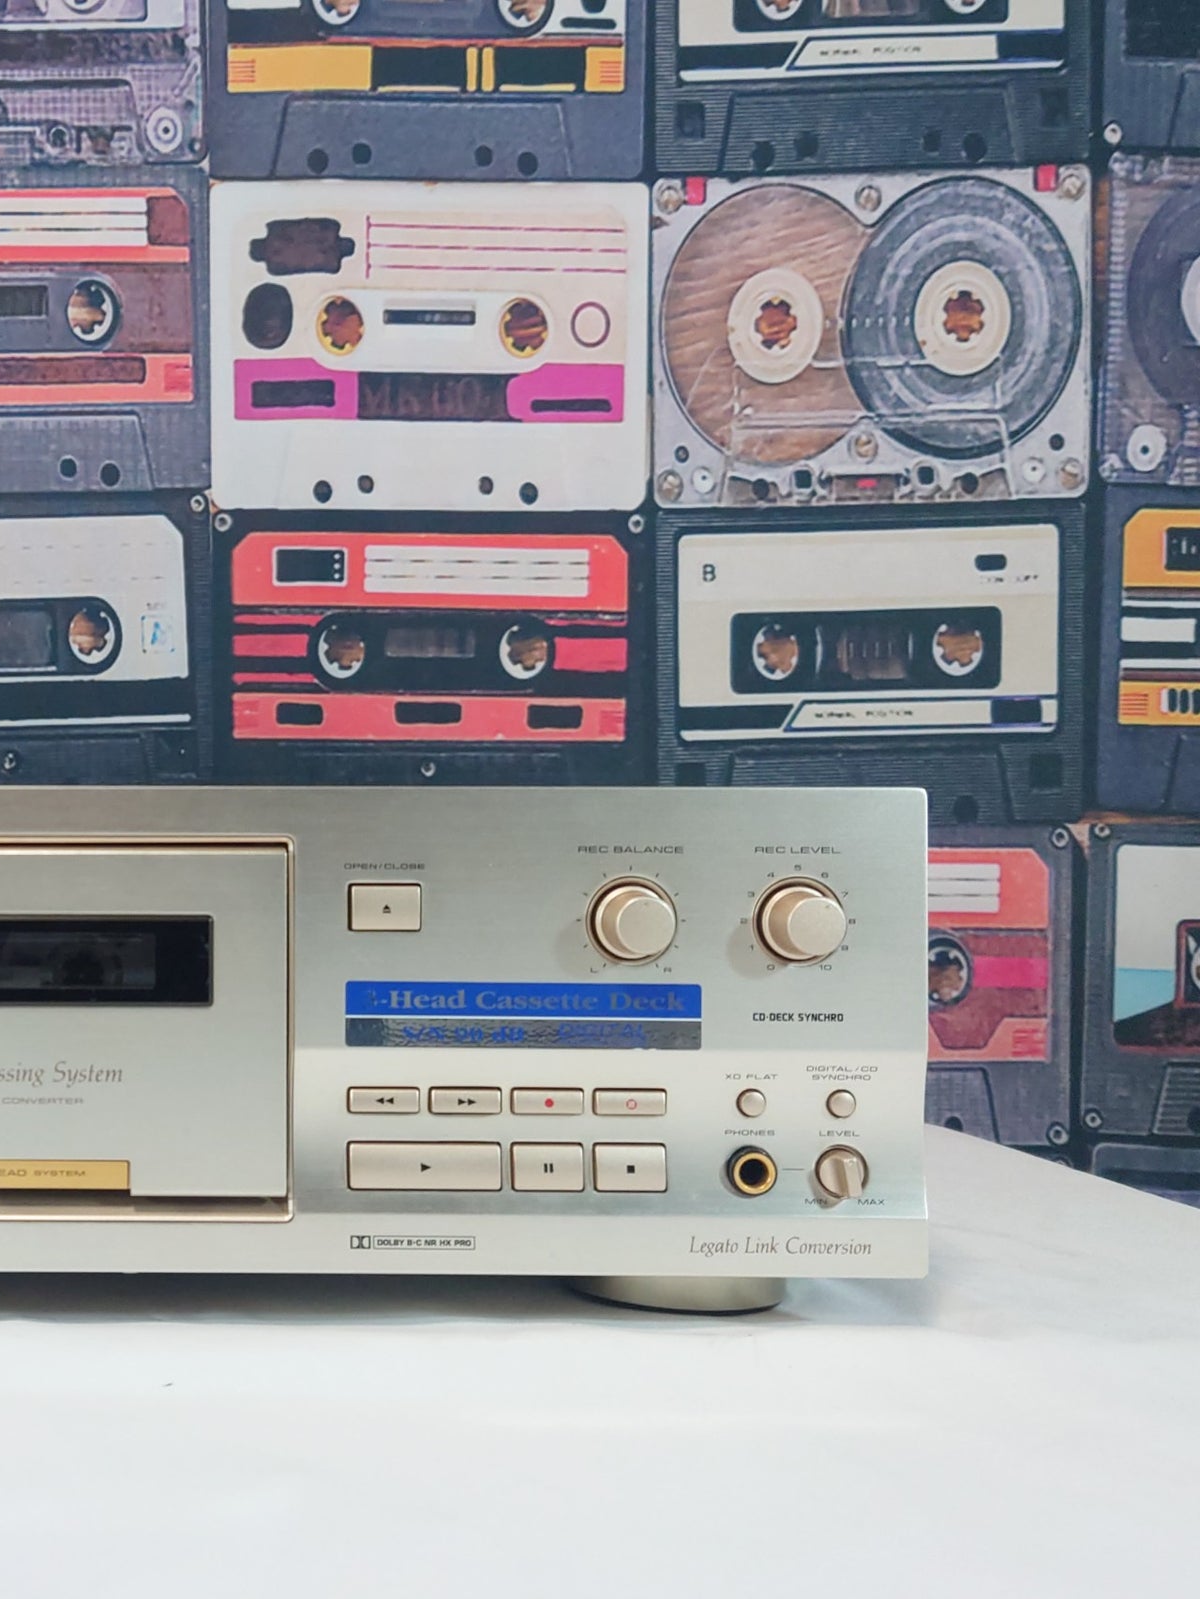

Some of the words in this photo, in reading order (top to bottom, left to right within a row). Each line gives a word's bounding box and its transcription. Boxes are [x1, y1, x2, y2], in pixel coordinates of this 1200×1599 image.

[702, 563, 716, 582] B
[577, 845, 609, 855] REC
[613, 845, 685, 855] BALANCE
[754, 845, 786, 855] REC
[790, 845, 841, 855] LEVEL
[343, 862, 426, 871] OPEN/CLOSE
[767, 871, 775, 879] 4
[819, 963, 832, 972] 10
[475, 990, 599, 1011] Cassette
[609, 992, 686, 1012] Deck
[797, 1013, 844, 1022] SYNCHRO
[52, 1060, 123, 1088] System
[2, 1096, 84, 1105] CONVERTER
[33, 1169, 86, 1177] SYSTEM
[805, 1198, 827, 1206] MIN
[454, 1239, 472, 1247] PRO
[689, 1236, 738, 1257] Legato
[745, 1236, 779, 1254] Link
[785, 1236, 872, 1255] Conversion
